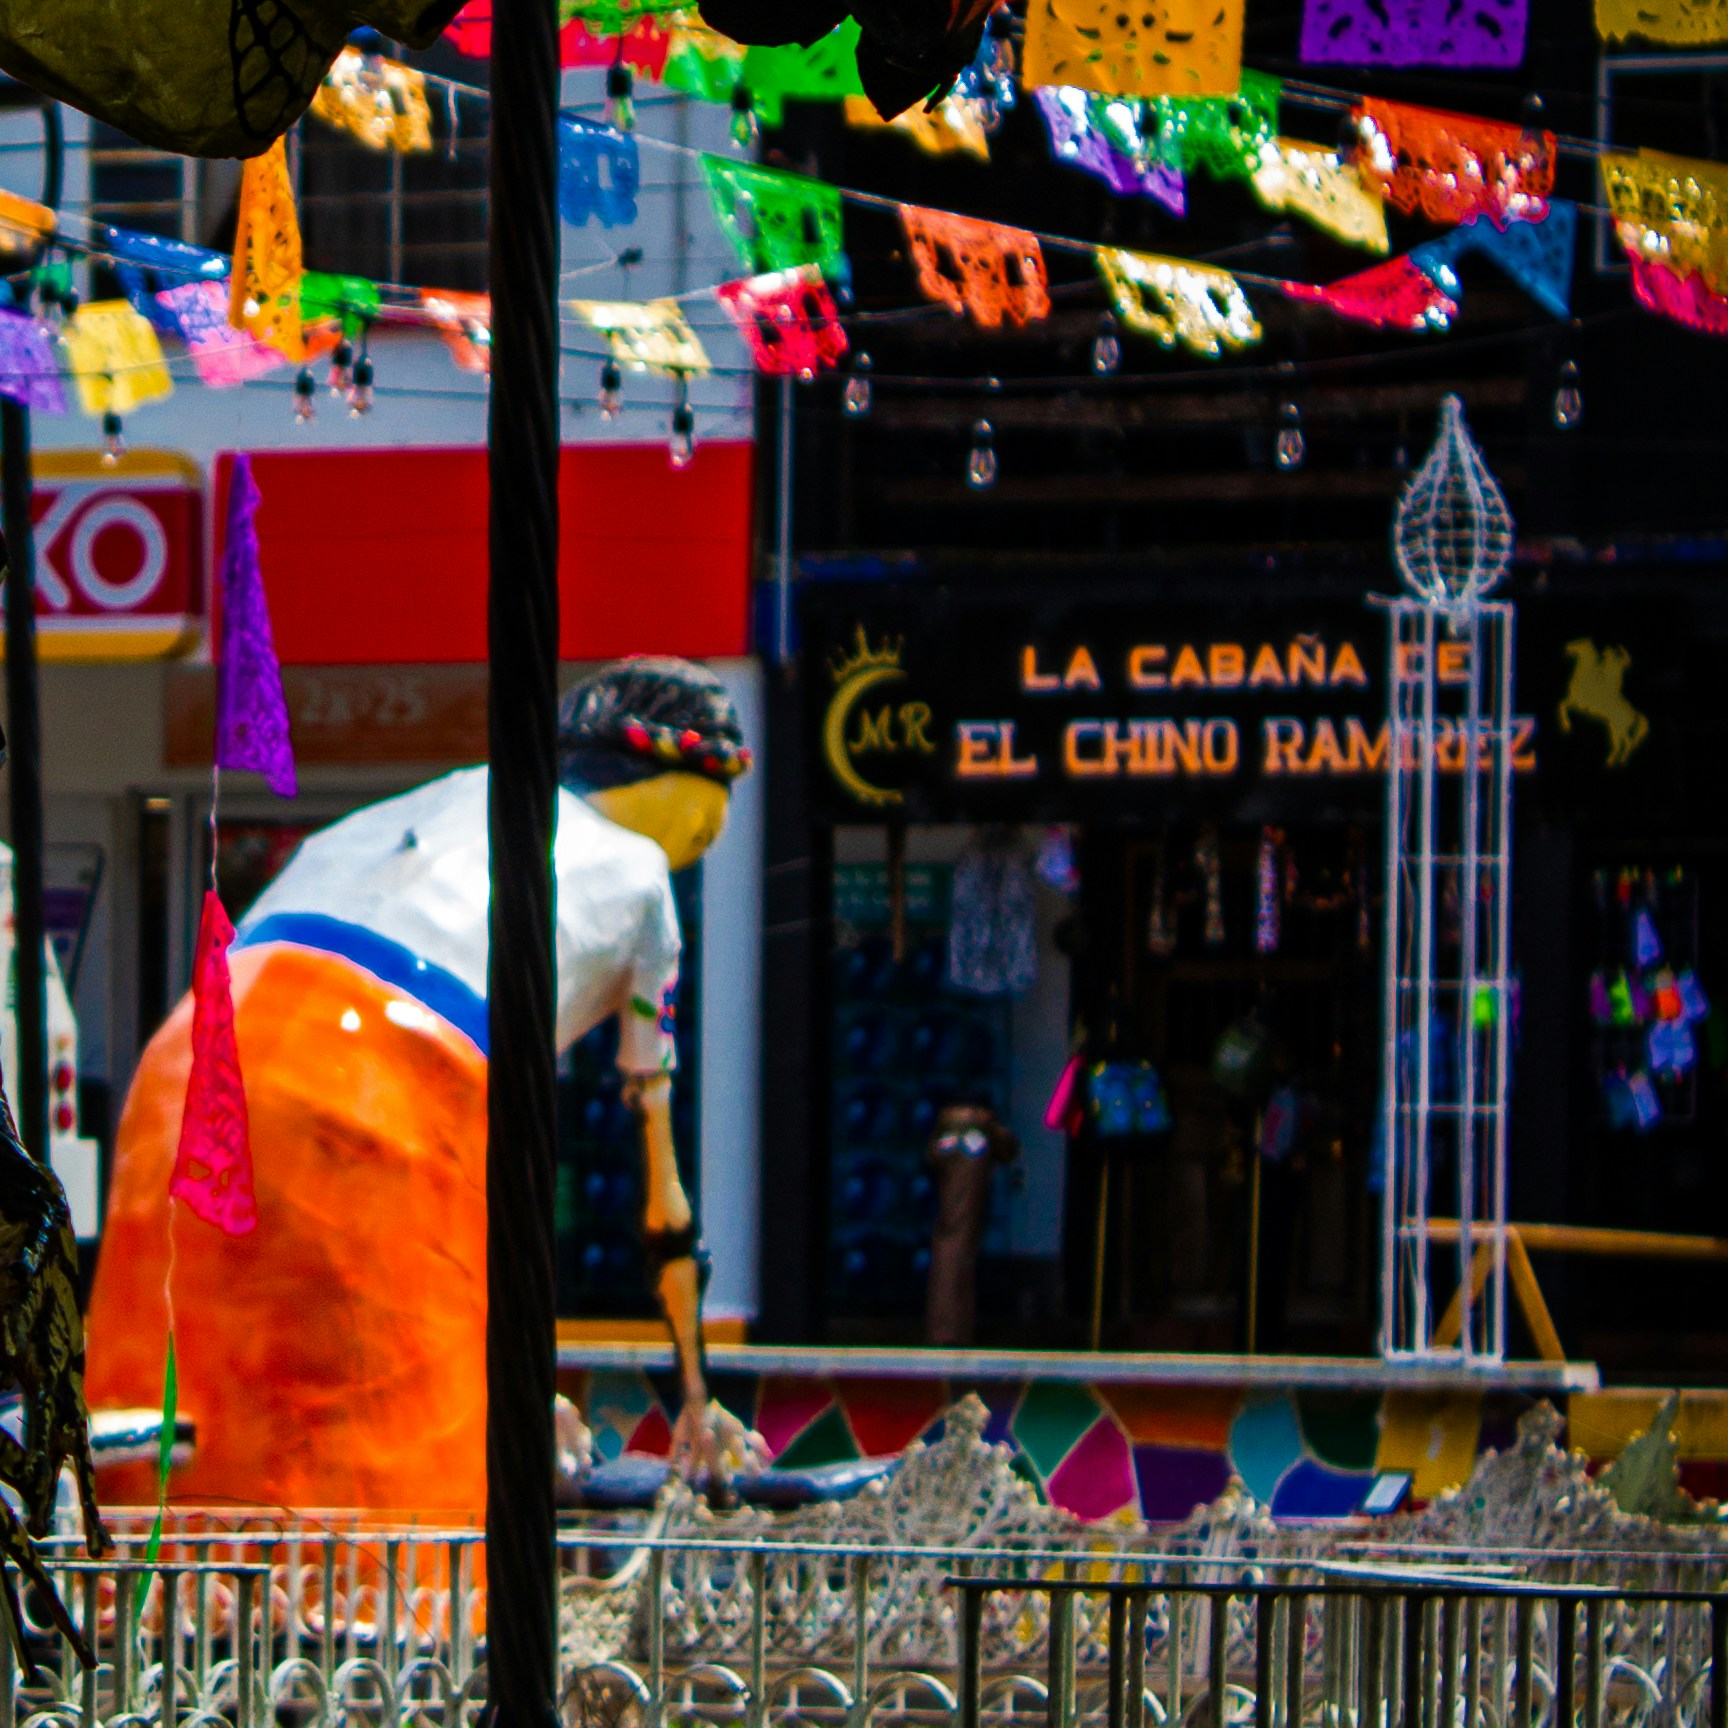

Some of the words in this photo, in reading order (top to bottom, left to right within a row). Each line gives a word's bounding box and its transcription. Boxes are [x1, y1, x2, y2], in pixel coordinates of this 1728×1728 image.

[4, 485, 170, 612] XO
[1018, 643, 1102, 691] LA
[1126, 632, 1368, 689] CABAÑA
[956, 717, 1038, 774] EL
[1062, 717, 1240, 774] CHINO
